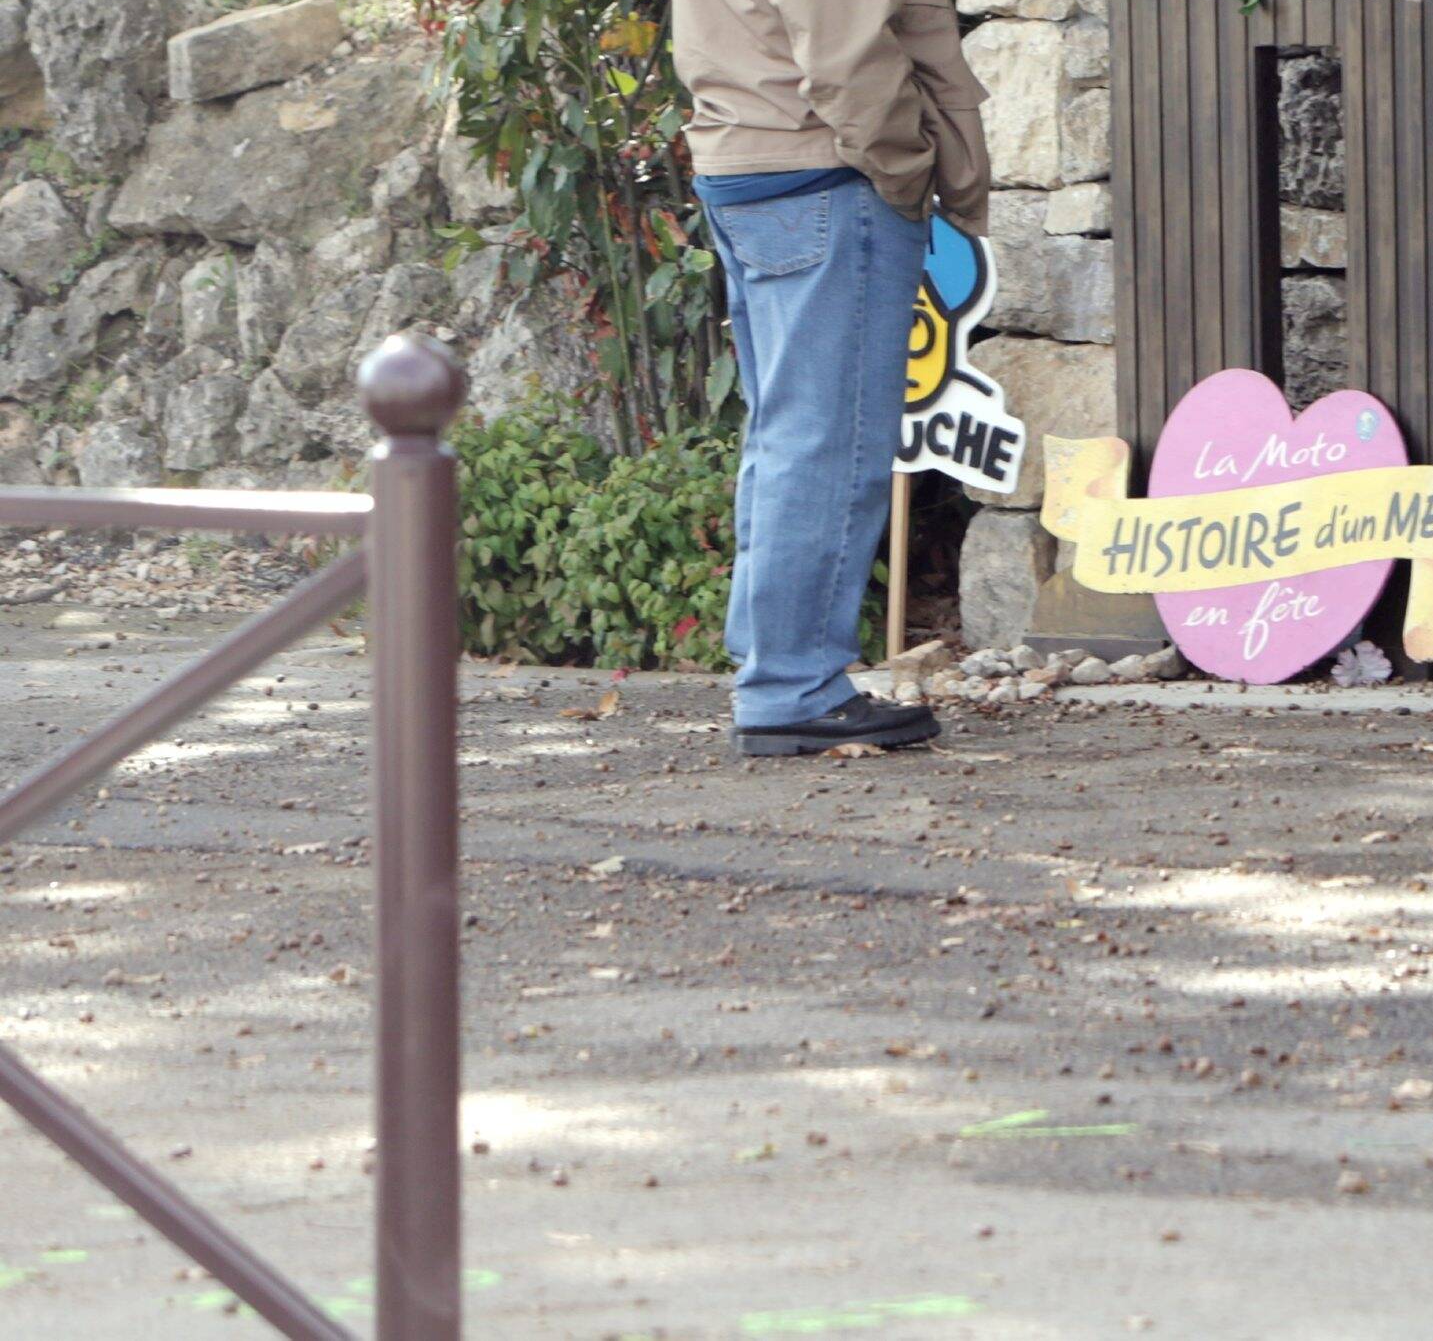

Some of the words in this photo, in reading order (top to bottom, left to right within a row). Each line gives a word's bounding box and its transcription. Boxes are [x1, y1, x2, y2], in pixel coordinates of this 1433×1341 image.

[900, 411, 1019, 482] UCHE
[1193, 440, 1239, 480] La
[1240, 432, 1347, 483] Moto
[1102, 501, 1302, 577] HISTOIRE
[1314, 504, 1377, 550] d'un
[1181, 604, 1230, 628] en
[1237, 581, 1326, 661] fête
